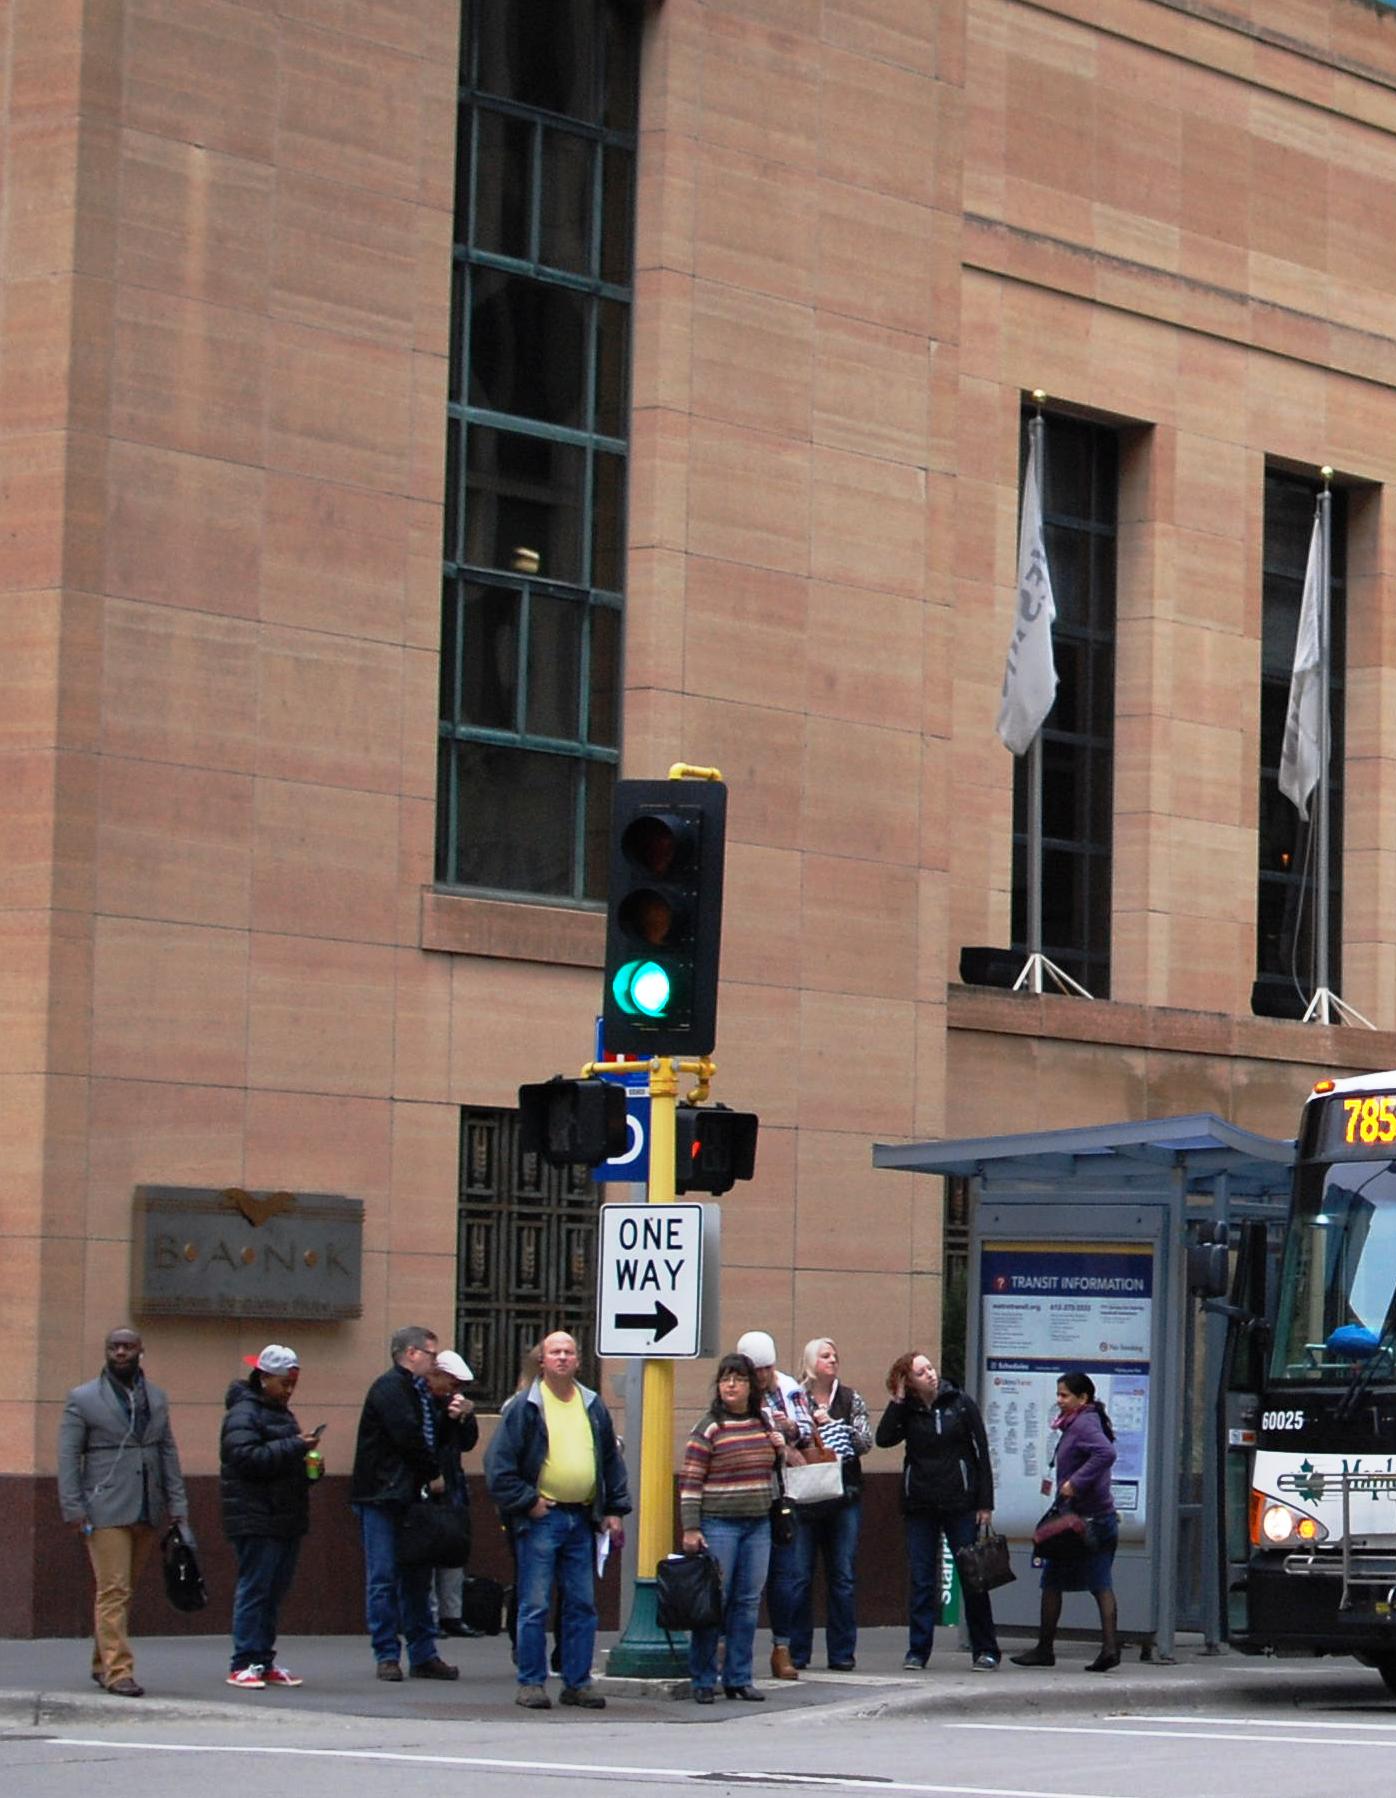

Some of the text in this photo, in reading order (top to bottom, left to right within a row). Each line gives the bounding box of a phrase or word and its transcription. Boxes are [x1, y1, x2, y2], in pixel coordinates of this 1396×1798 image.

[619, 1218, 683, 1250] ONE
[616, 1258, 685, 1291] WAY
[1011, 1275, 1145, 1292] TRANSIT INFORMATION
[1261, 1410, 1305, 1431] 60025
